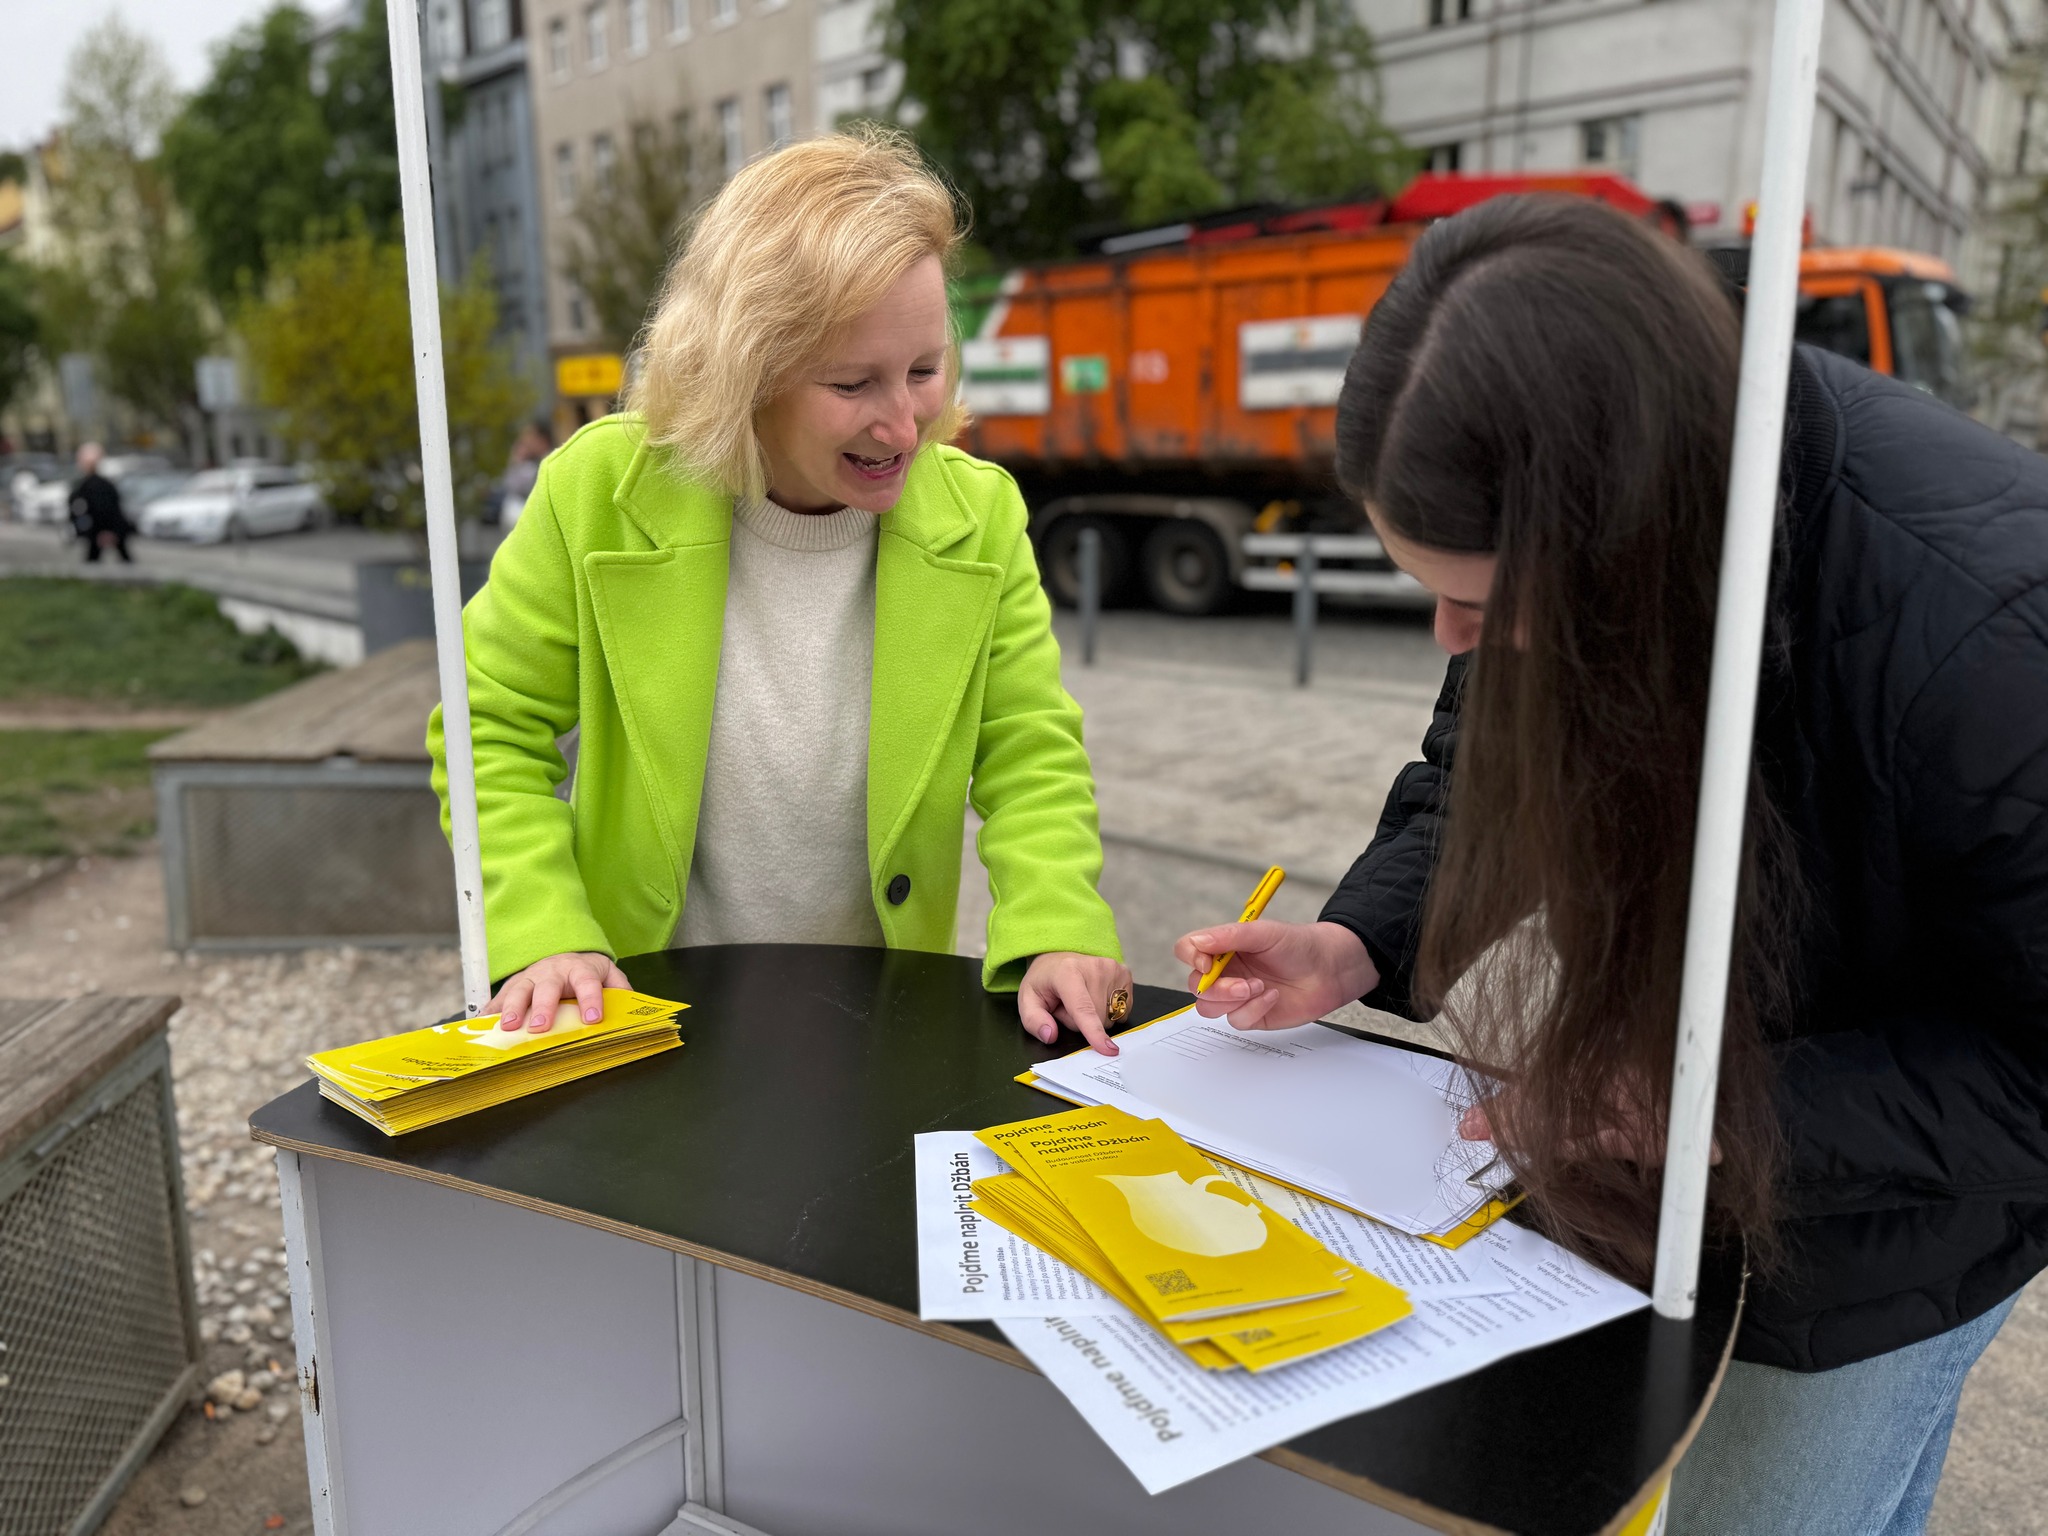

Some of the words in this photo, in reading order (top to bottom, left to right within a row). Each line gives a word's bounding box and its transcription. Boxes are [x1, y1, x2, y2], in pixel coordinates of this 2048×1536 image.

[994, 1124, 1052, 1140] Pojďme
[1030, 1134, 1092, 1148] Pojďme
[1038, 1141, 1096, 1156] naplnit
[1100, 1134, 1150, 1148] Džbán
[1045, 1153, 1091, 1164] Budoucnost
[1093, 1149, 1122, 1158] Džbánu
[1070, 1157, 1096, 1165] vašich
[950, 1152, 972, 1192] Džbán
[954, 1194, 982, 1238] naplnit
[1333, 1226, 1348, 1242] Lokalita
[996, 1246, 1004, 1260] Džbán
[959, 1241, 988, 1294] Pojďme
[998, 1262, 1008, 1281] amfiteátr
[1024, 1256, 1034, 1277] charakter
[1001, 1282, 1011, 1300] Přírodní
[1014, 1274, 1026, 1299] Navrhovaný
[1056, 1282, 1067, 1298] Projekt
[1106, 1372, 1182, 1442] Pojďme
